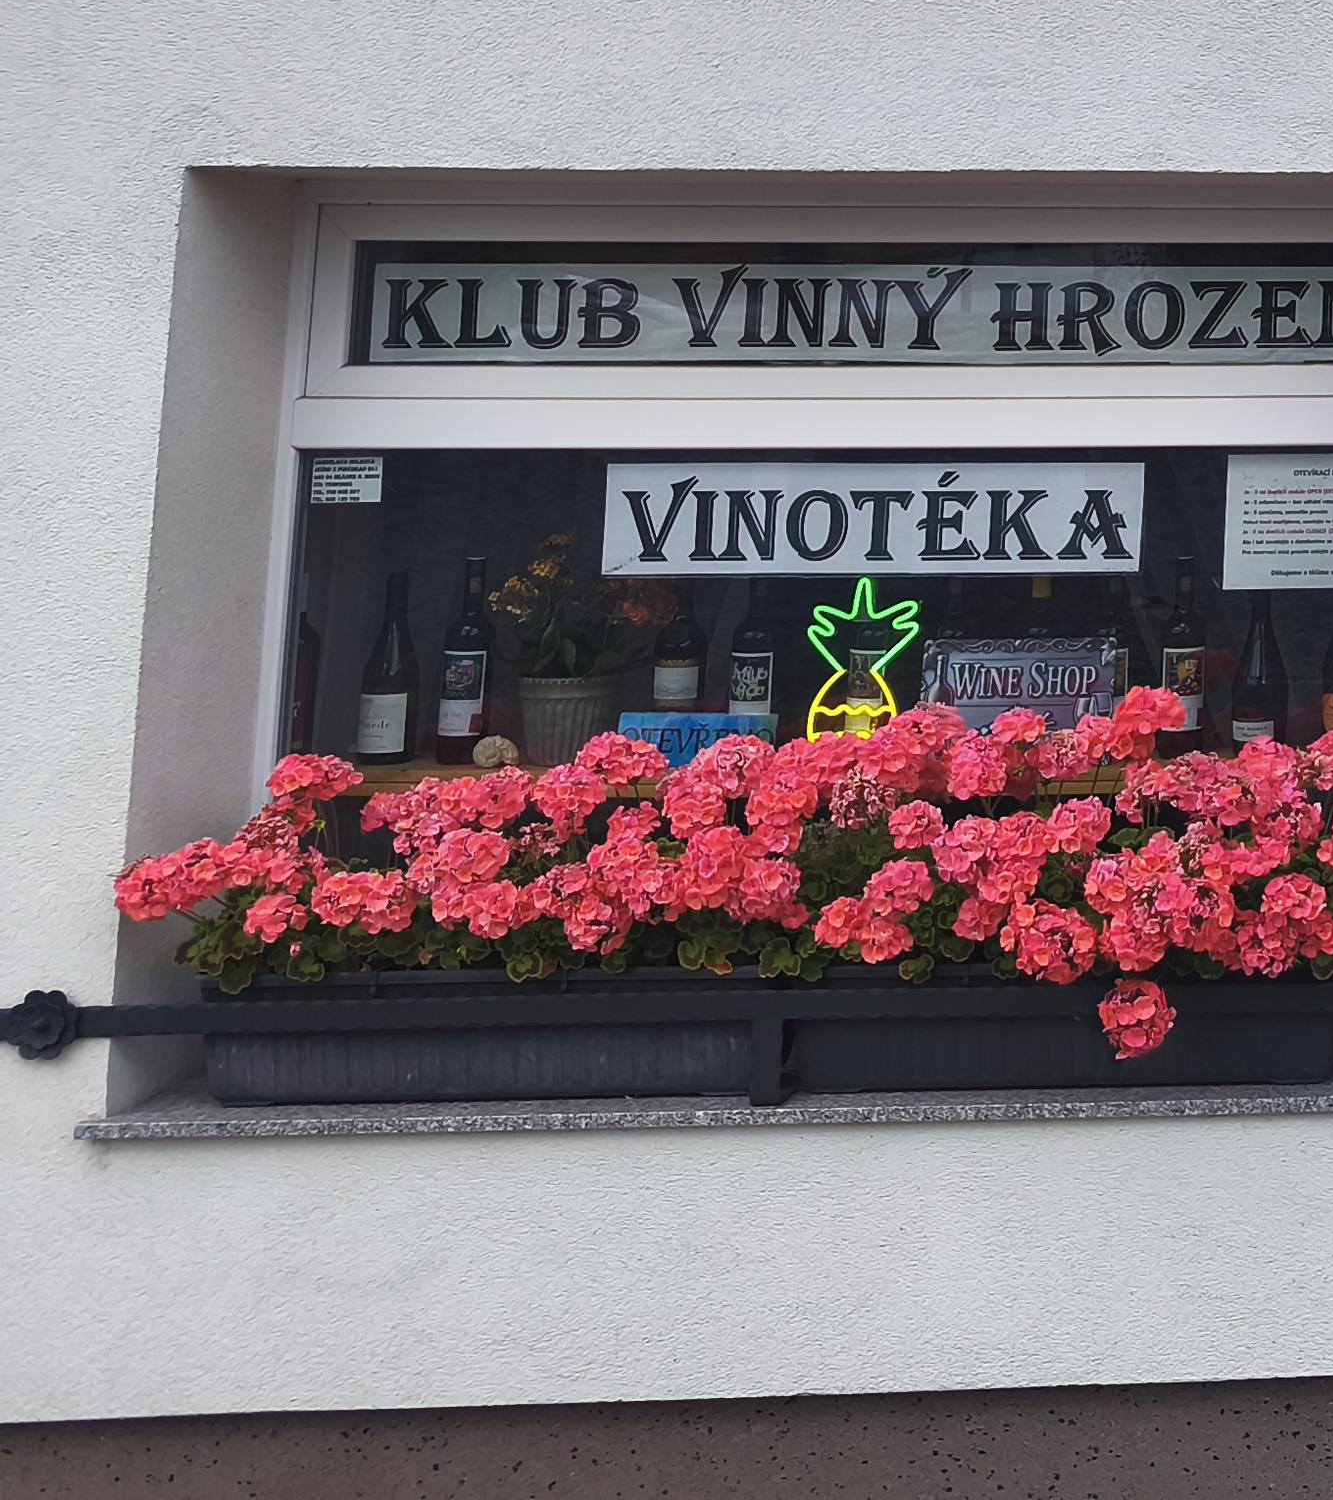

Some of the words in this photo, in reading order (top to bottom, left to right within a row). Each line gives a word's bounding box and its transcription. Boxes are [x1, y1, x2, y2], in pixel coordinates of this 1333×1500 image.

[382, 277, 641, 350] KLUB
[672, 264, 973, 351] VINNÝ
[622, 470, 1135, 562] VINOTÉKA
[951, 662, 1023, 699] WINE
[1028, 661, 1098, 697] SHOP
